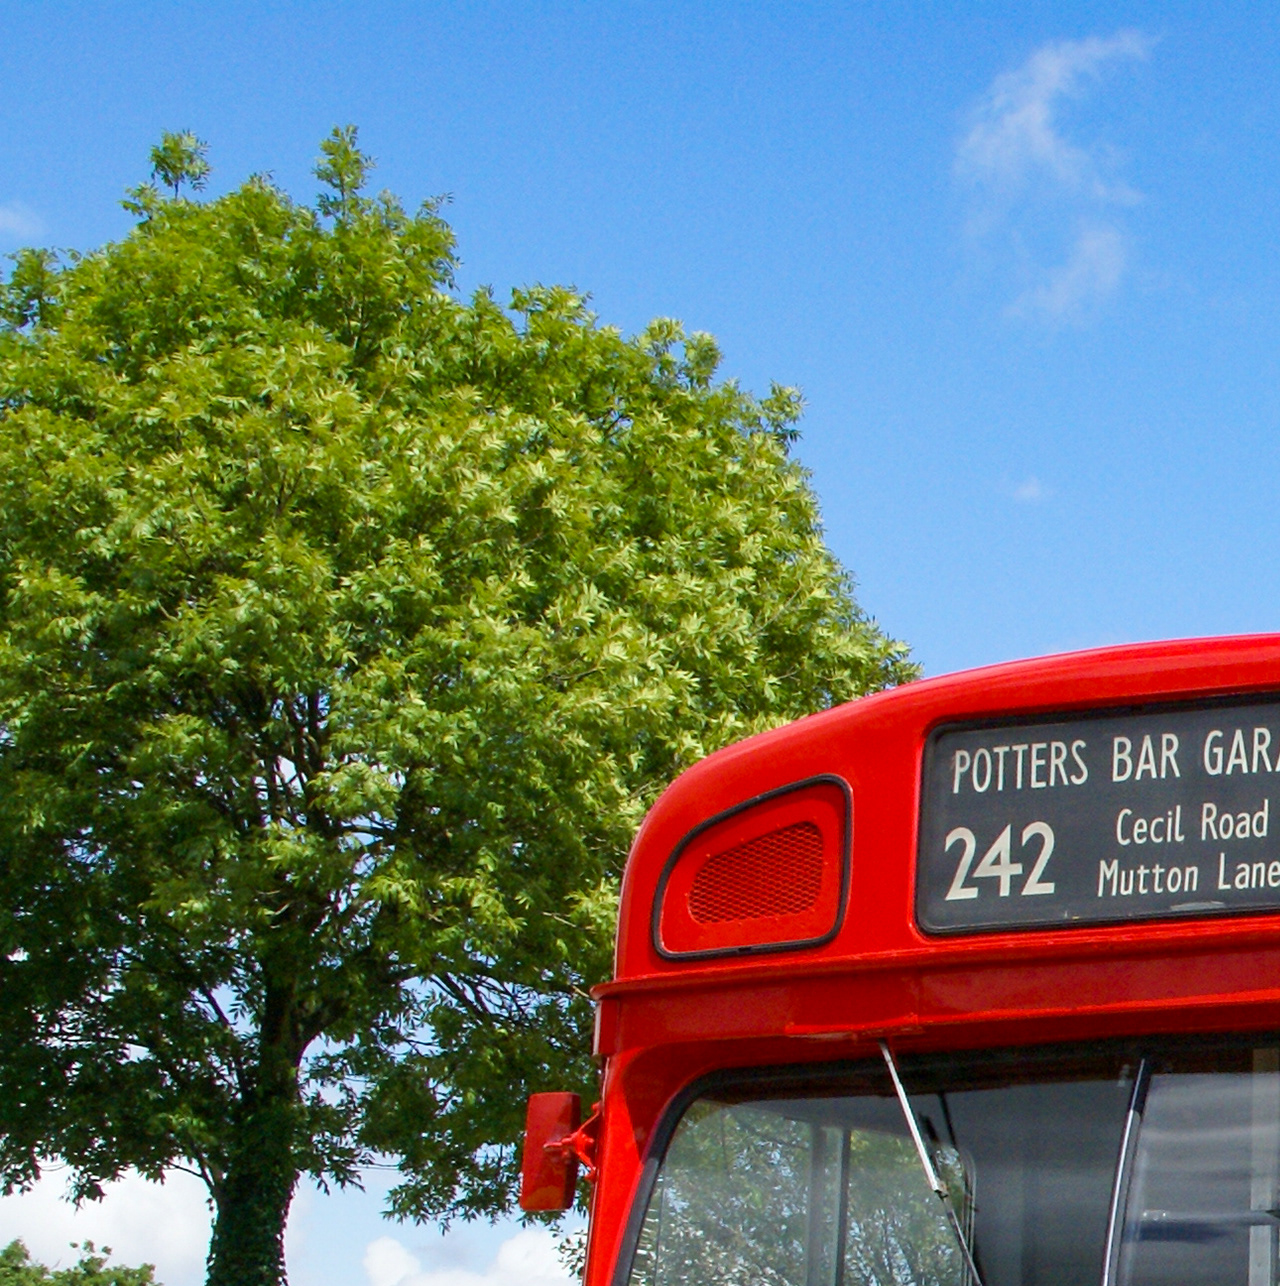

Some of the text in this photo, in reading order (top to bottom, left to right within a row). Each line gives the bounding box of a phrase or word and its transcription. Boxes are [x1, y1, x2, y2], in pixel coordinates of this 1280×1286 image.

[952, 739, 1089, 795] POTTERS
[1112, 733, 1181, 783] BAR
[1116, 798, 1270, 847] Cecil Road
[945, 820, 1056, 901] 242
[1097, 858, 1199, 898] Mutton
